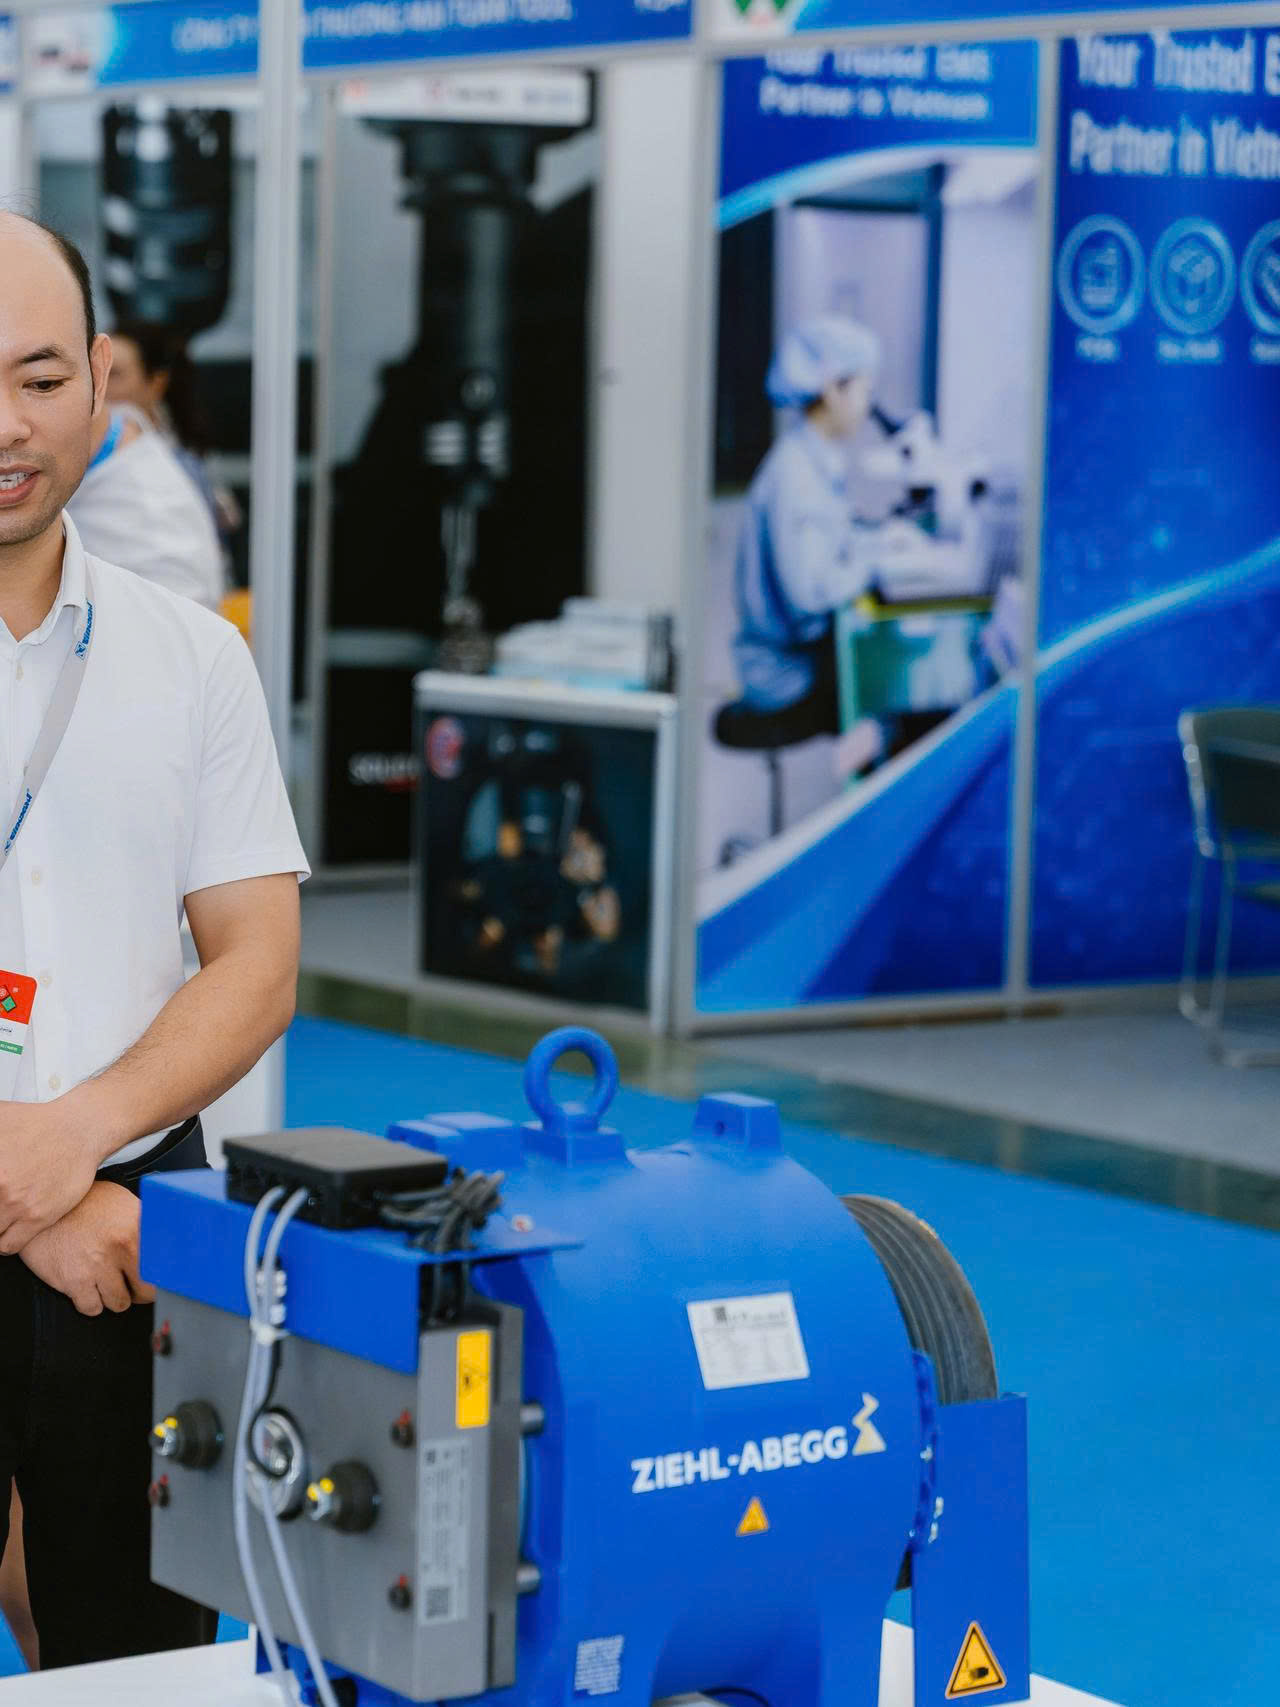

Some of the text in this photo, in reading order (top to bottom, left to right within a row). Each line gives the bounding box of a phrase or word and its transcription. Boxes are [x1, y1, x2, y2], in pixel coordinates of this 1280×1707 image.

[1077, 32, 1139, 88] Your
[1152, 28, 1253, 93] Trusted
[1071, 109, 1173, 175] Partner
[1178, 113, 1207, 176] in
